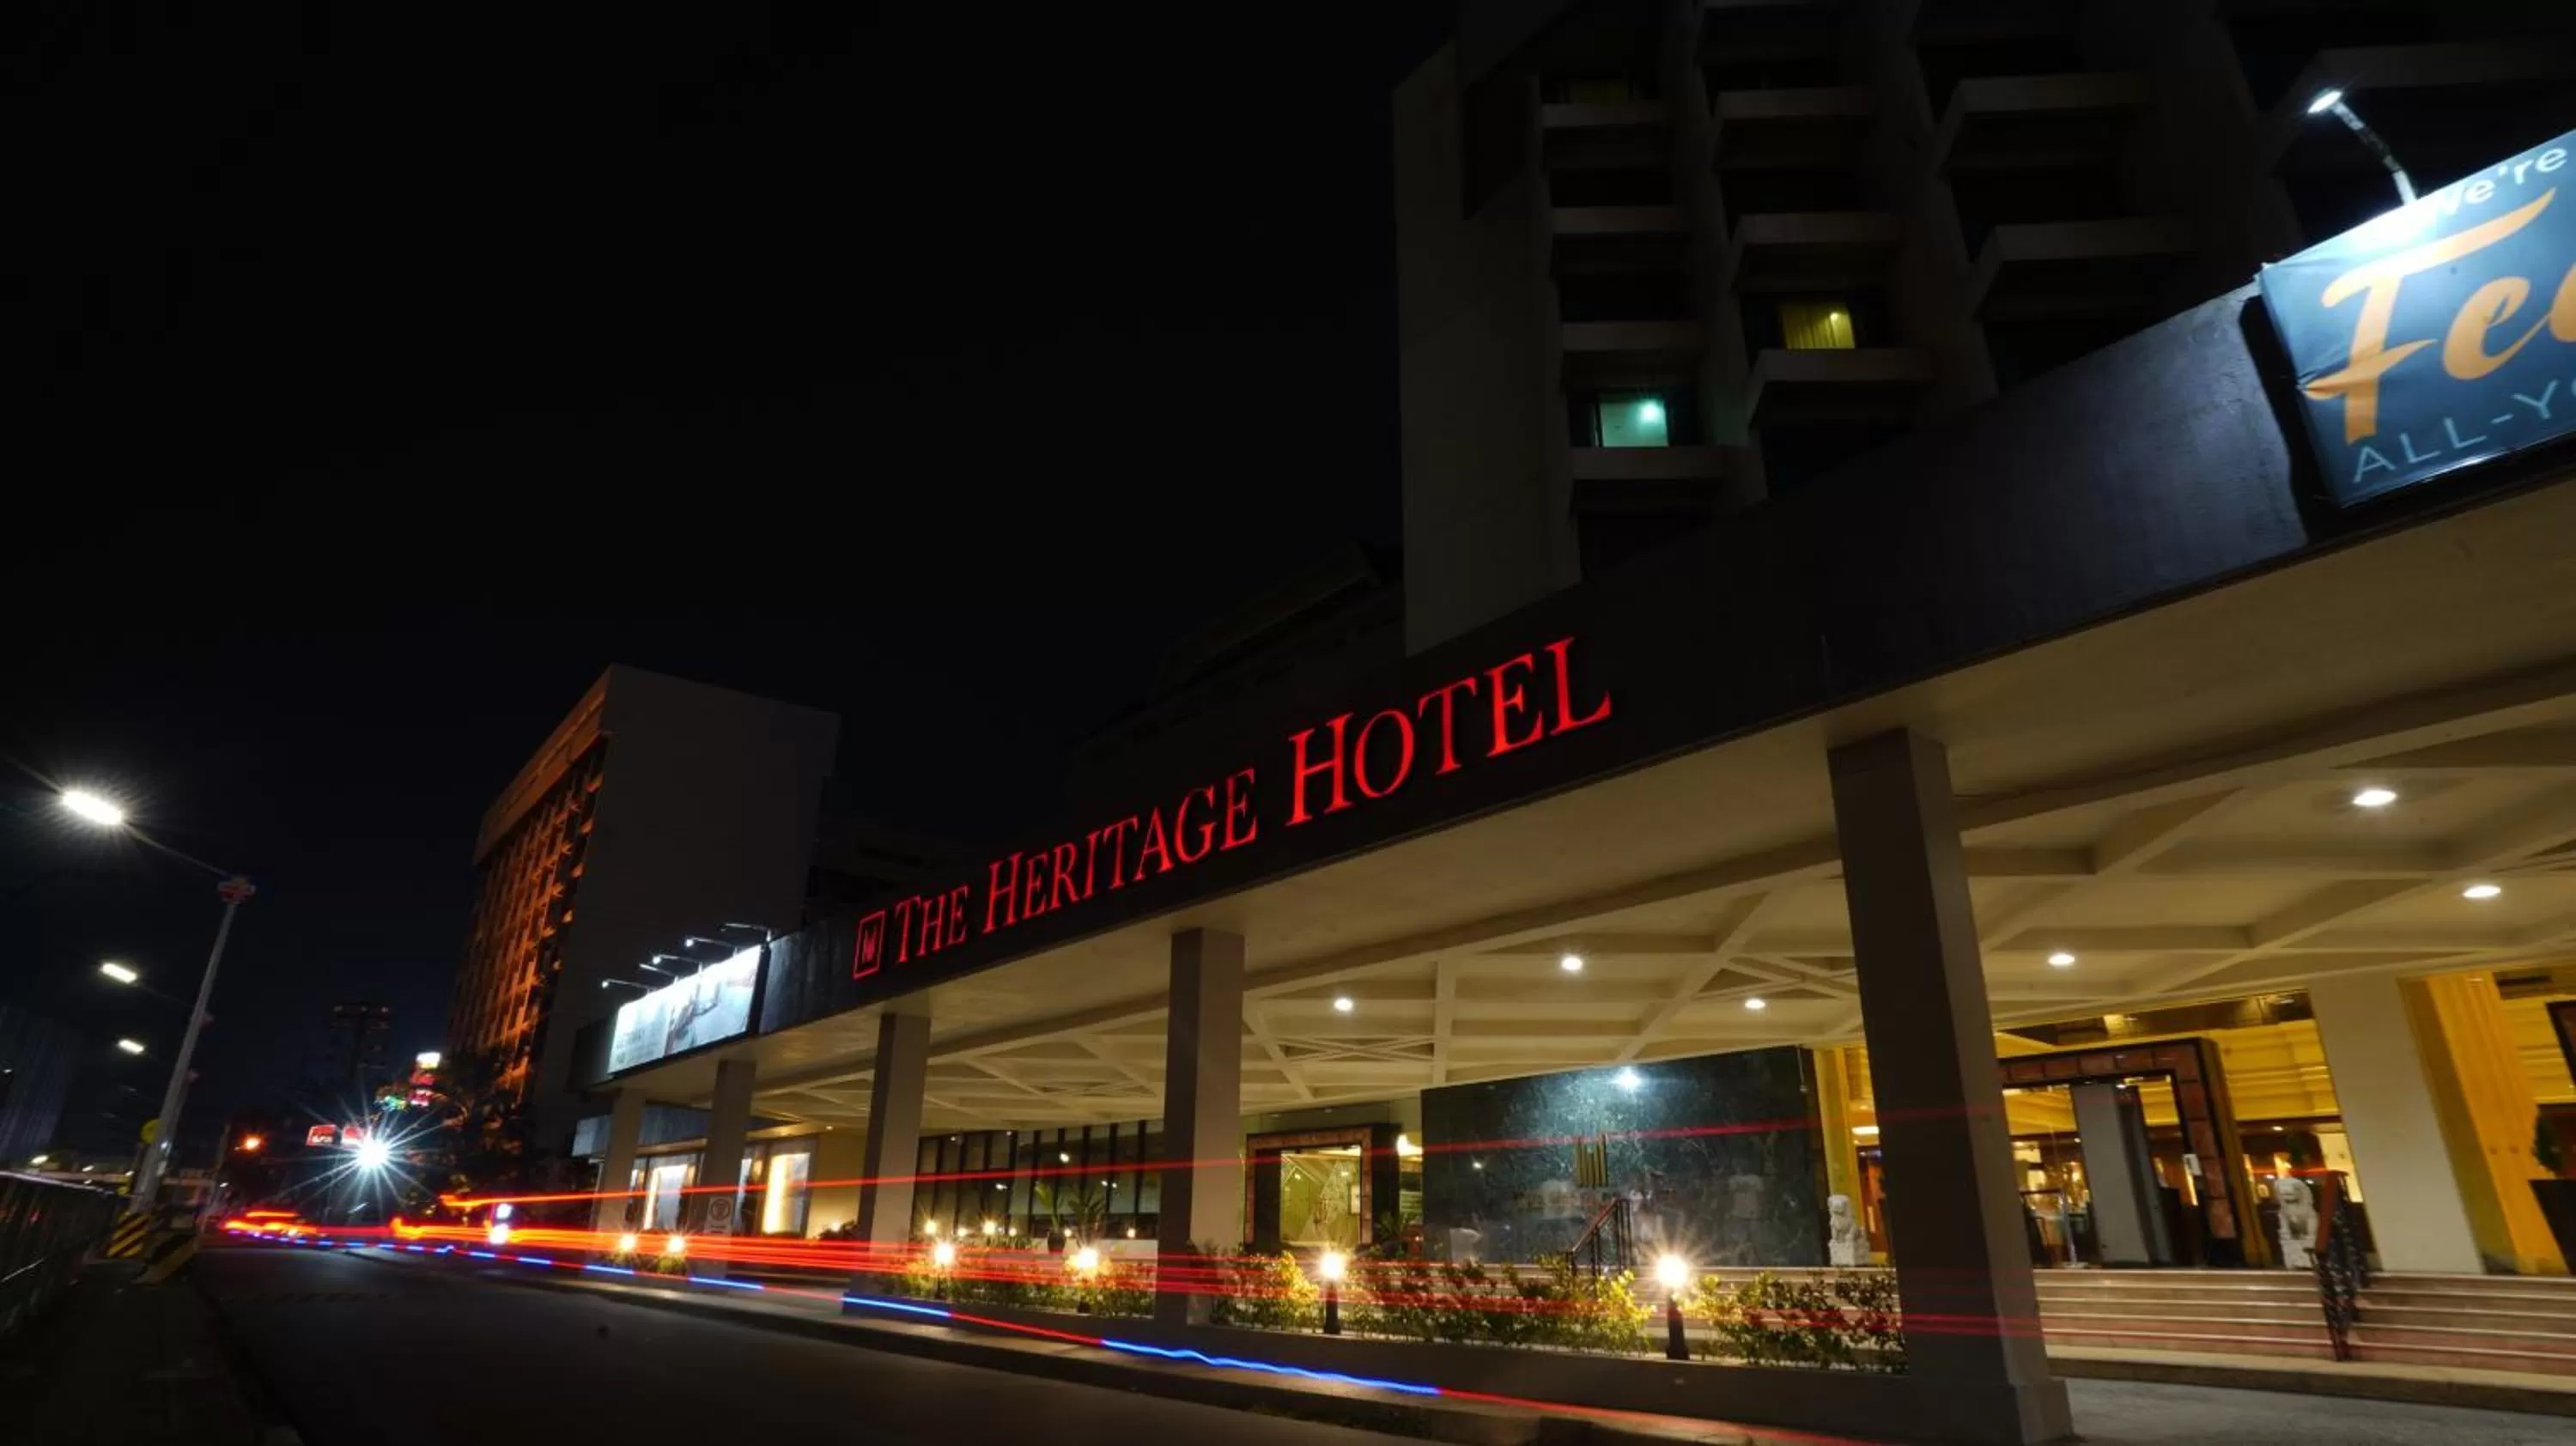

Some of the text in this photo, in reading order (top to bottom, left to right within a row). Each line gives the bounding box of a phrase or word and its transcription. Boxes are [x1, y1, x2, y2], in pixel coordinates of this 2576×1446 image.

[2353, 378, 2576, 483] ALL-Y
[894, 637, 1613, 963] THE HERITAGE HOTEL
